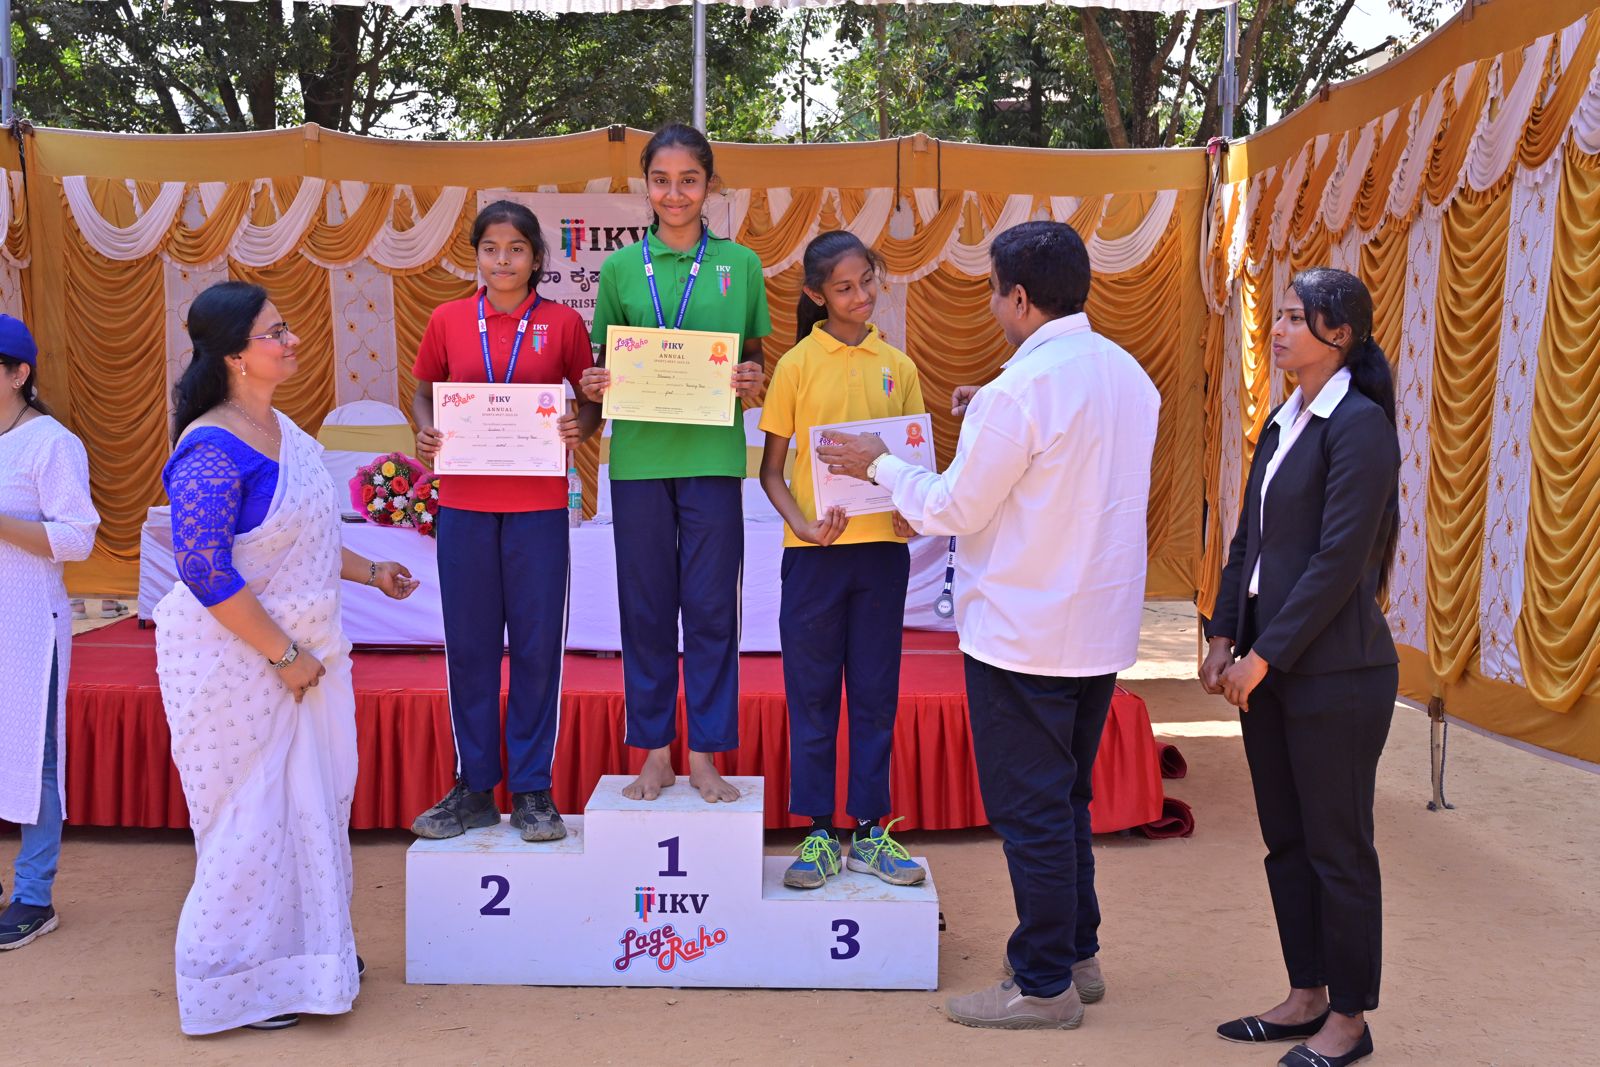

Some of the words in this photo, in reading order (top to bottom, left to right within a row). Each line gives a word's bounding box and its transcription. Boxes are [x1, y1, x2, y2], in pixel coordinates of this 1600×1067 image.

[658, 836, 687, 877] 1
[479, 874, 511, 916] 2
[657, 893, 710, 914] IKV
[614, 925, 675, 971] Lage
[657, 926, 726, 971] Raho
[830, 918, 861, 960] 3
